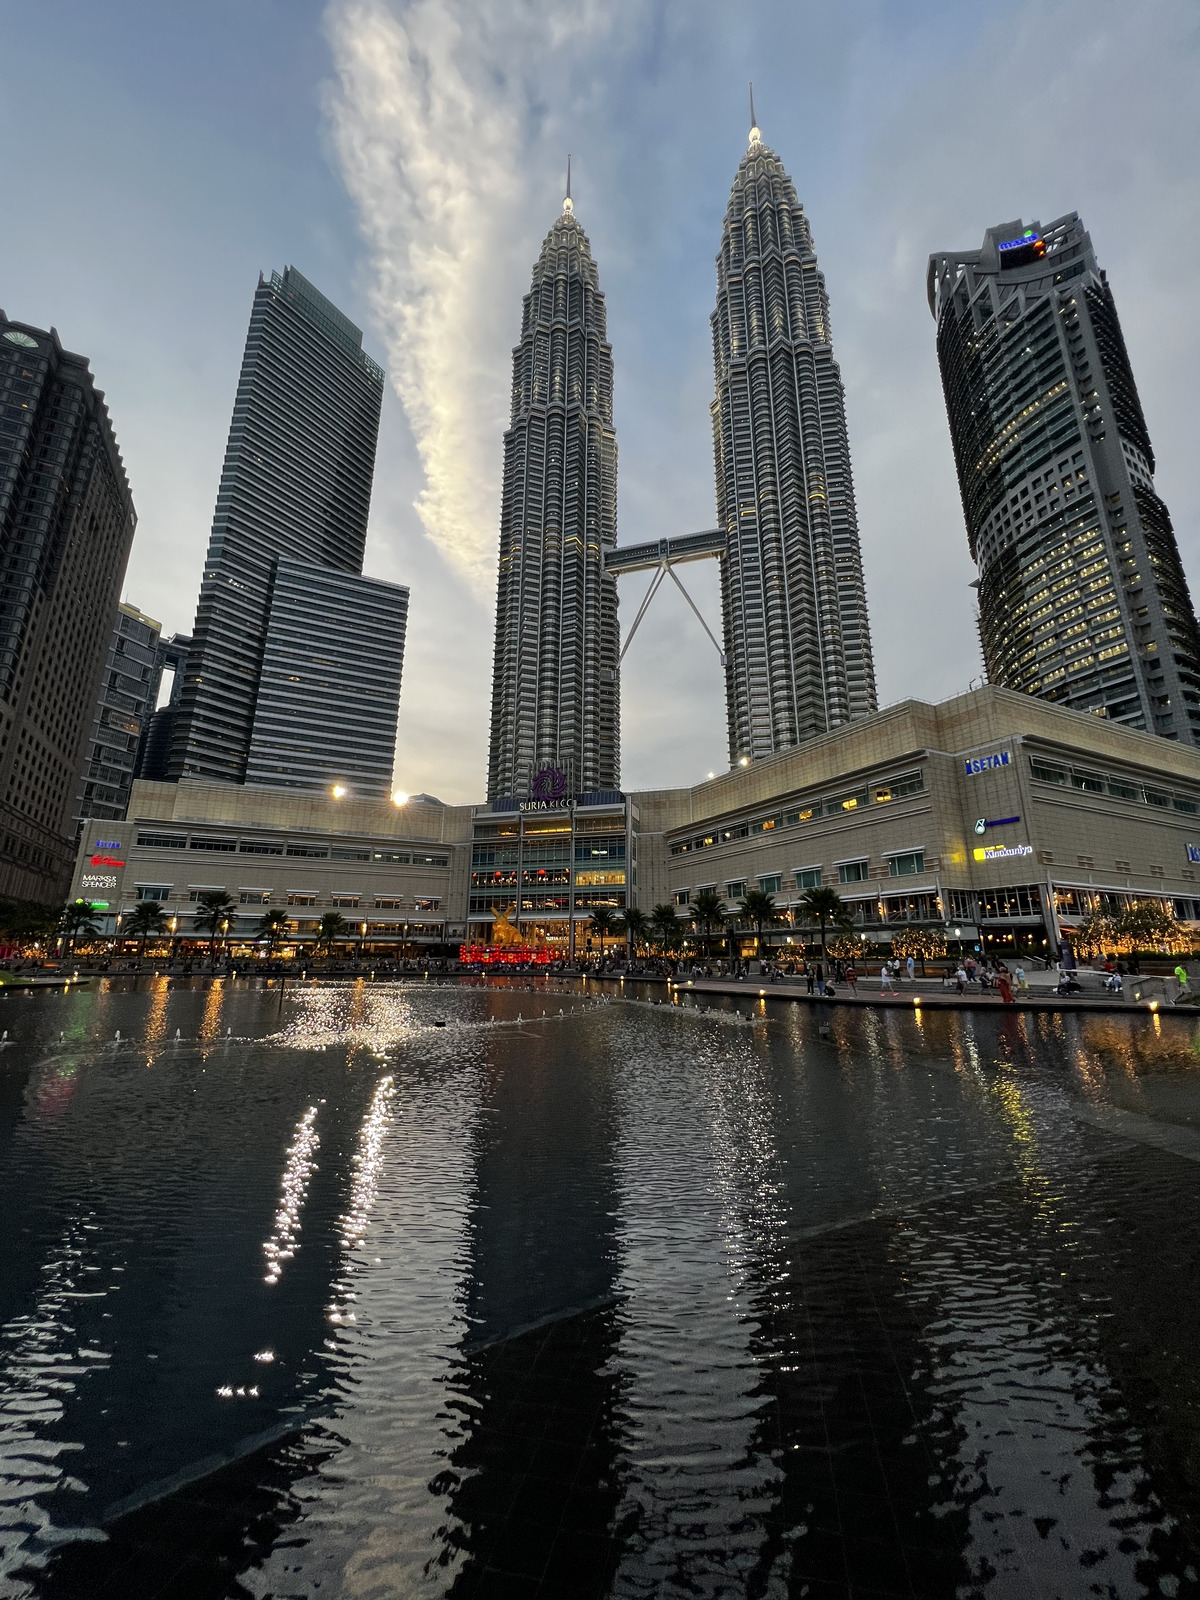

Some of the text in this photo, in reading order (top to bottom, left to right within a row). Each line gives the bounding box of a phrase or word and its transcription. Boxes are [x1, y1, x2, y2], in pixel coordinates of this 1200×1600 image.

[999, 233, 1039, 250] maxis
[519, 800, 548, 812] SURIA
[985, 844, 1033, 858] Kinokuniya
